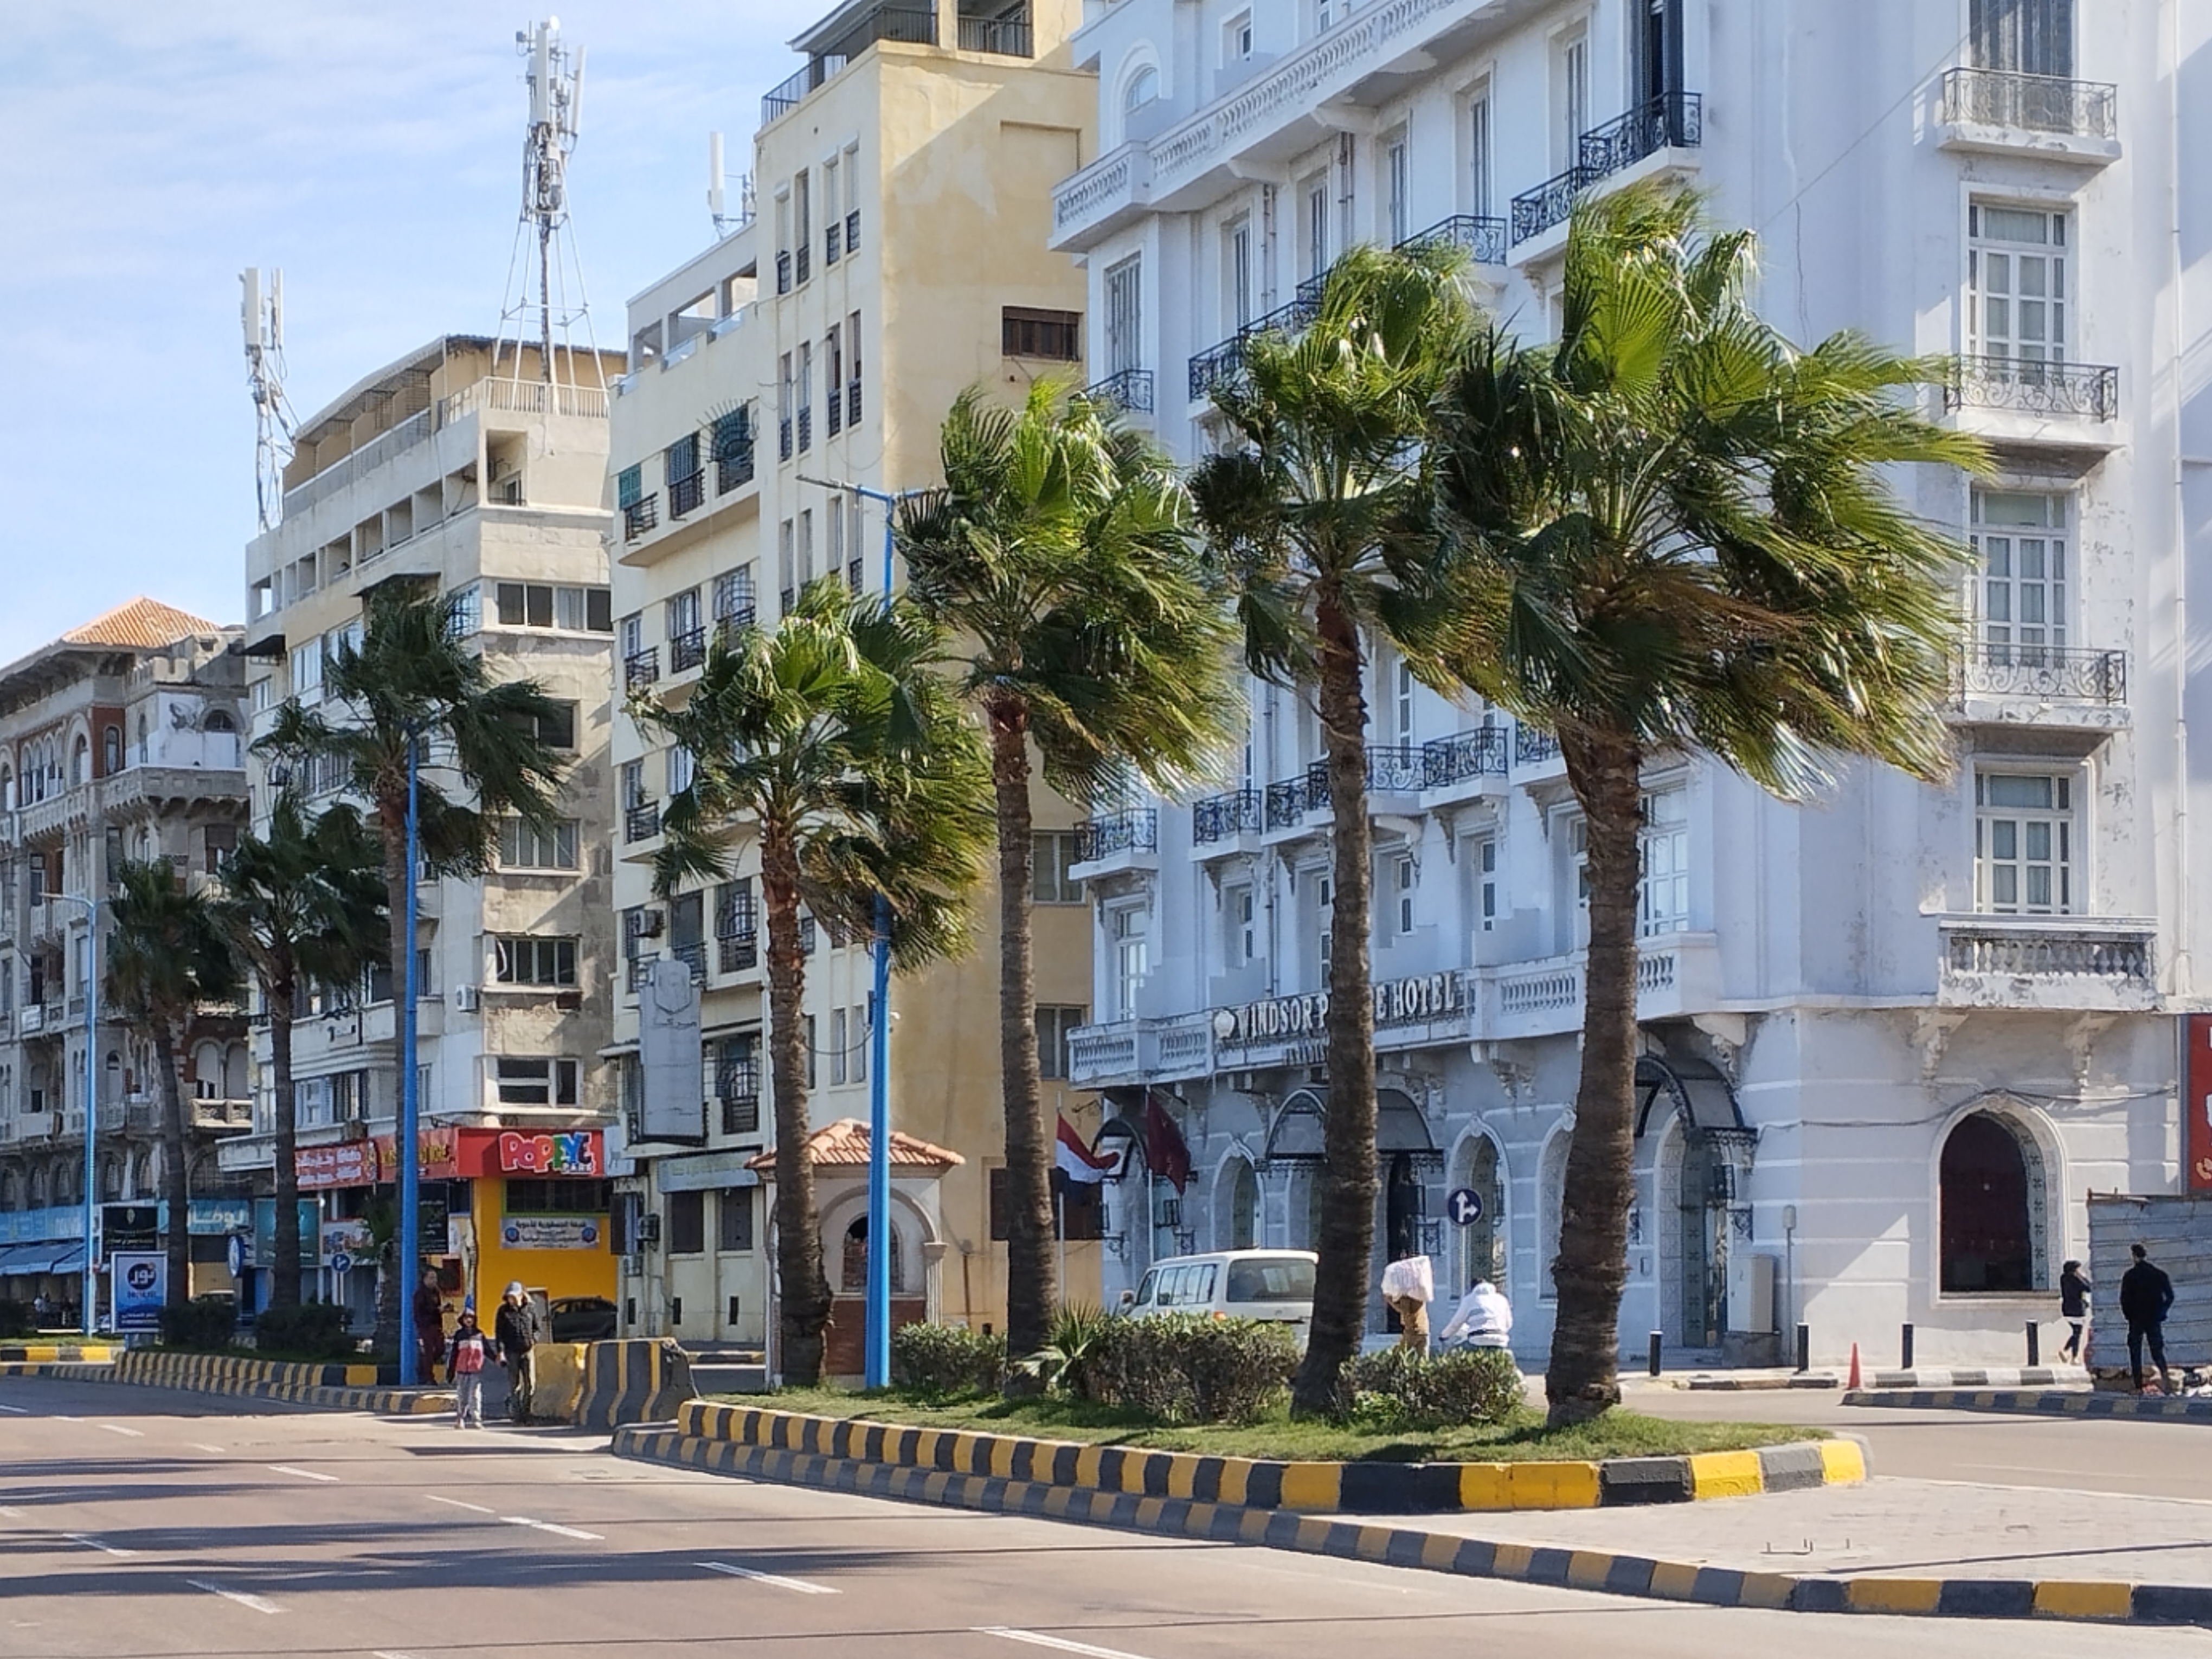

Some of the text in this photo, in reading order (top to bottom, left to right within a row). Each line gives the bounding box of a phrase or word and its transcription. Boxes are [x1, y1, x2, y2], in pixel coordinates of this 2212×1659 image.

[1237, 998, 1313, 1040] WINDSOR
[1393, 973, 1455, 1017] HOTEL
[500, 1132, 593, 1173] POPEYE
